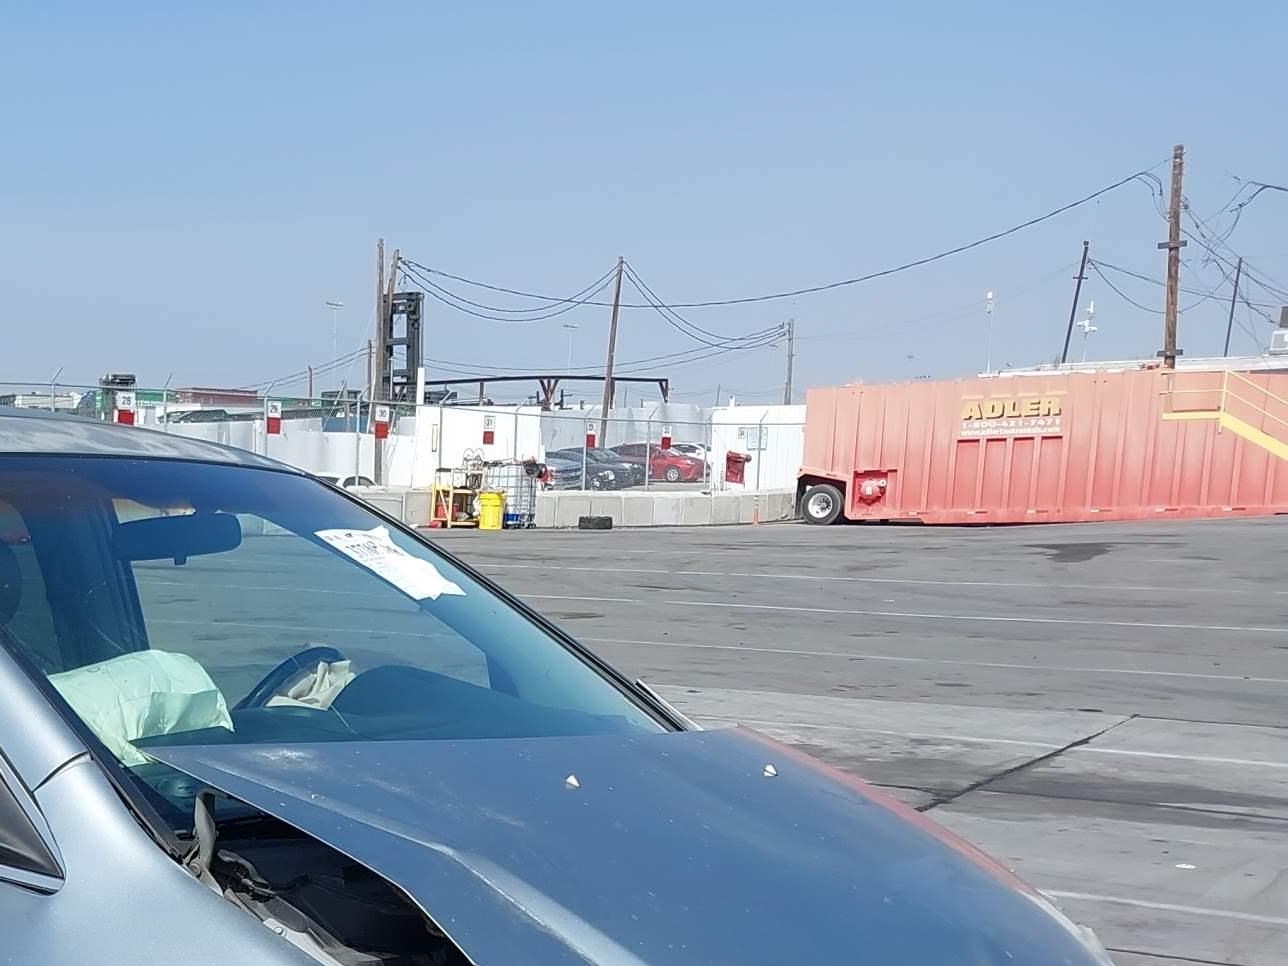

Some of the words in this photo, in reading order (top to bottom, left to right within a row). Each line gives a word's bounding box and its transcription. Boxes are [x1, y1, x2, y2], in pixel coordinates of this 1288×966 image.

[122, 396, 131, 406] 28
[377, 408, 387, 418] 30
[960, 398, 1062, 420] ADLER
[961, 419, 1061, 429] 1-800-421-7471
